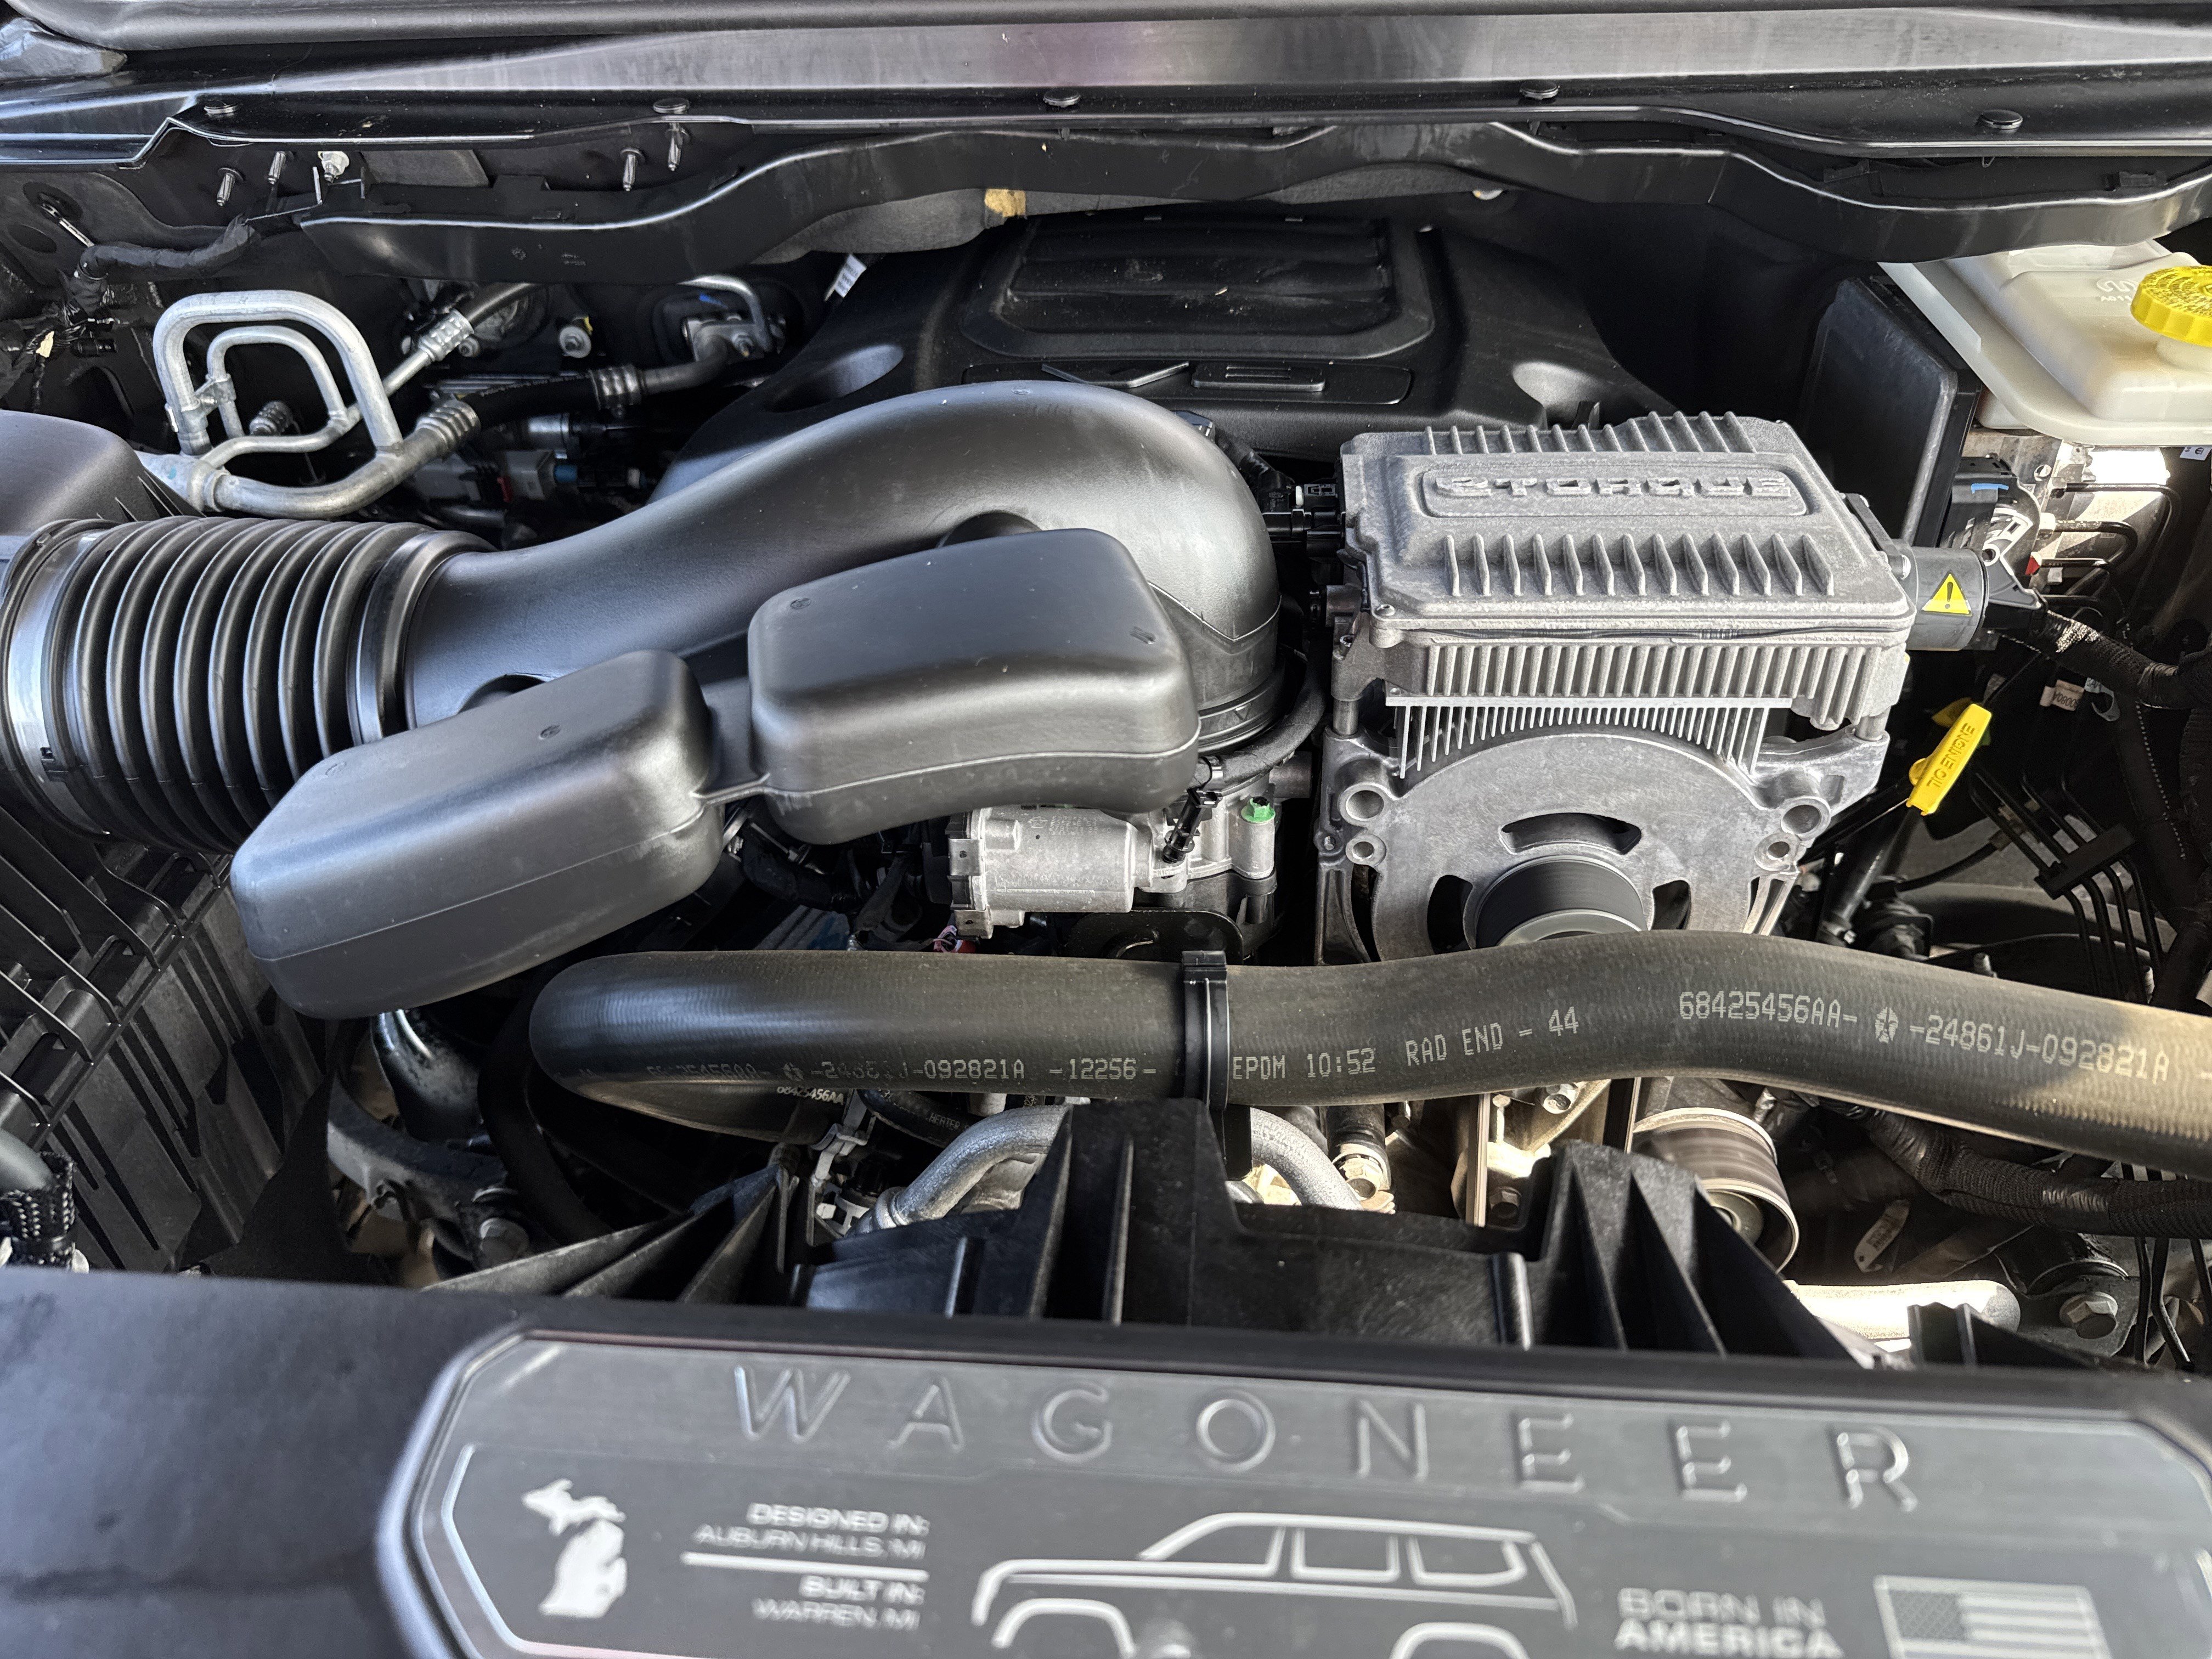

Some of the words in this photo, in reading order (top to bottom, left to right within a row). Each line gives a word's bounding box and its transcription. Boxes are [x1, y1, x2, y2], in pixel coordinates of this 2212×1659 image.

[1939, 723, 1975, 770] ENGINE
[1926, 768, 1948, 787] OIL
[1679, 990, 1858, 1029] 68425456AA-
[1233, 1055, 1286, 1080] EPDM
[1307, 1048, 1376, 1078] 10:52
[1406, 1035, 1447, 1066] RAD
[1462, 1023, 1504, 1056] END
[1548, 1006, 1579, 1036] 44
[733, 1366, 1918, 1513] WAGONEER
[747, 1503, 888, 1533] DESIGNED
[692, 1523, 808, 1553] AUBURN
[888, 1537, 926, 1560] MI
[799, 1575, 882, 1601] BUILT
[881, 1607, 921, 1631] MI
[1618, 1588, 1760, 1625] BORN
[1773, 1596, 1826, 1629] IN
[1613, 1618, 1844, 1658] AMERICA
